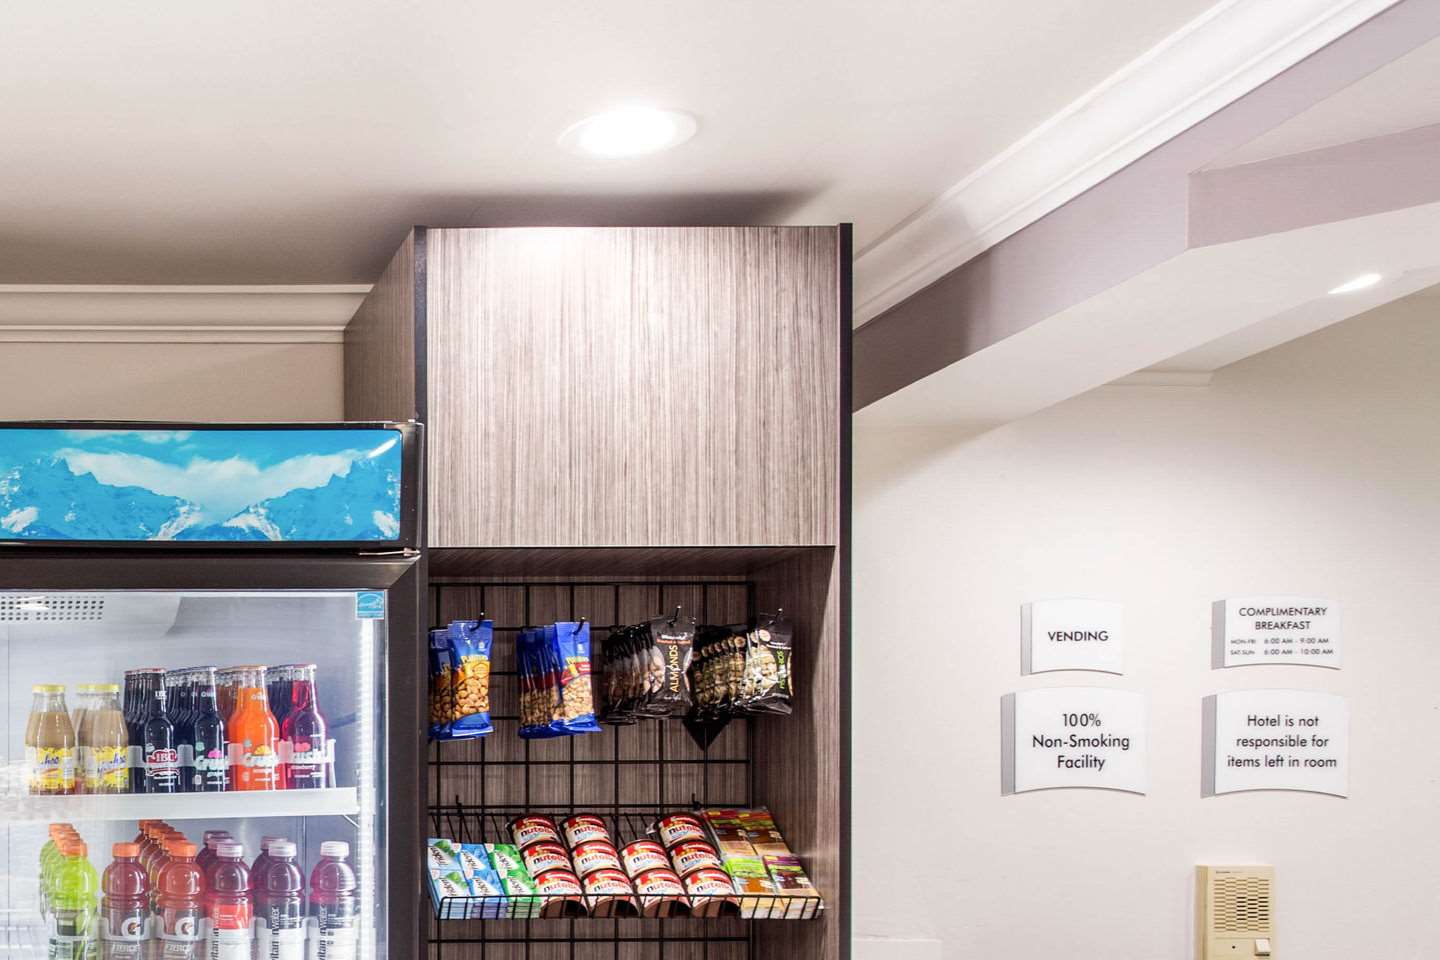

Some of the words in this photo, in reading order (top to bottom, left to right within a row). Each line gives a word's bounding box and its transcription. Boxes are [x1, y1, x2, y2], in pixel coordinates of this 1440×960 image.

[1238, 607, 1328, 617] COMPLIMENTARY
[1255, 621, 1311, 630] BREAKFAST
[1047, 630, 1109, 642] VENDING
[669, 644, 681, 693] ALMONDS
[1061, 712, 1102, 727] 100%
[1247, 714, 1281, 727] Hotel
[1285, 714, 1295, 727] is
[1299, 716, 1319, 727] not
[1032, 734, 1131, 751] Non-Smoking
[1236, 734, 1307, 751] responsible
[1311, 734, 1329, 748] for
[156, 751, 176, 762] IBC
[1057, 754, 1106, 772] Facility
[1227, 755, 1260, 768] items
[1264, 755, 1285, 768] left
[1289, 756, 1300, 768] in
[1304, 758, 1337, 769] room
